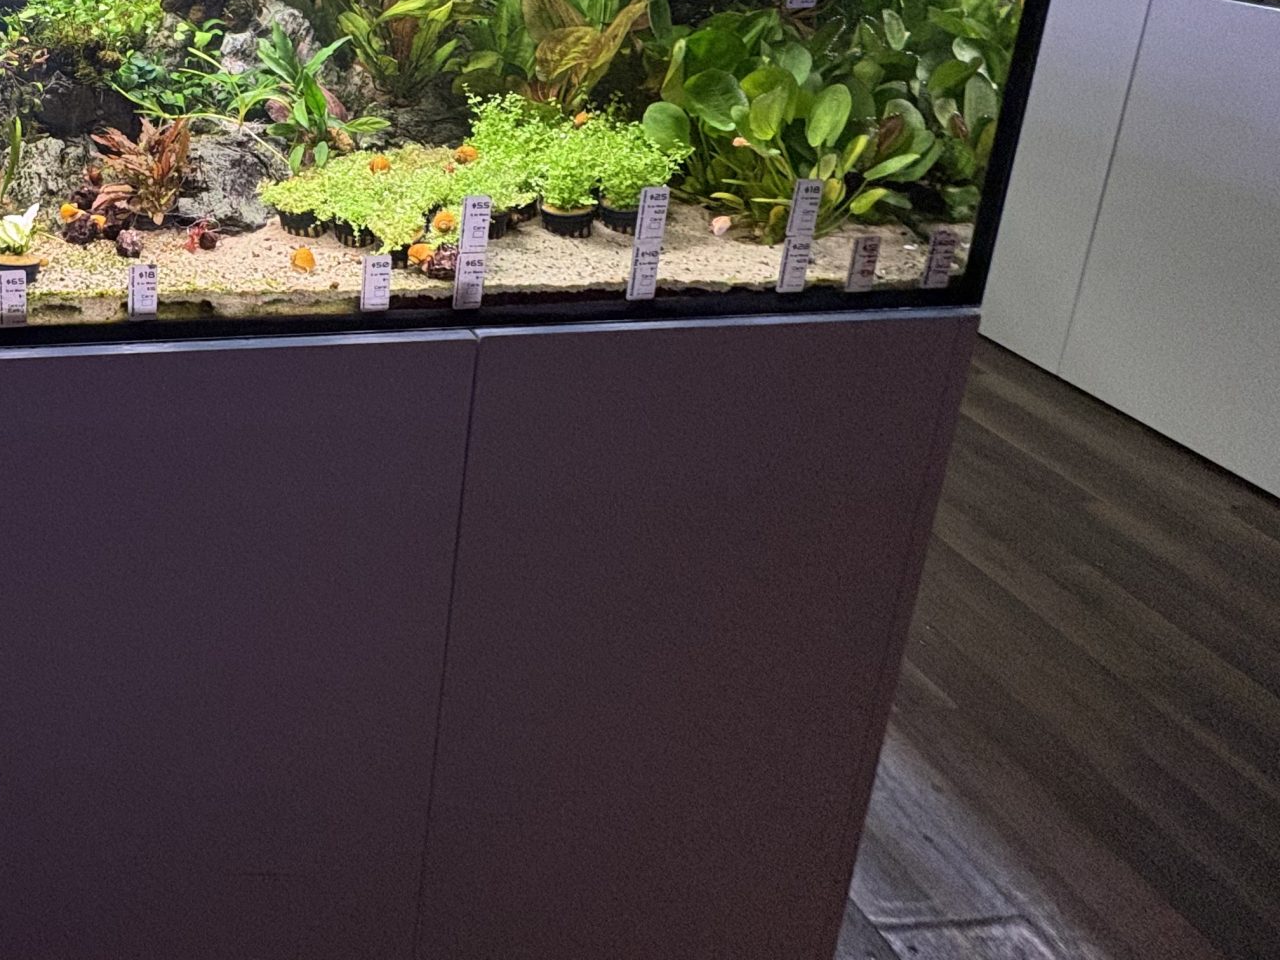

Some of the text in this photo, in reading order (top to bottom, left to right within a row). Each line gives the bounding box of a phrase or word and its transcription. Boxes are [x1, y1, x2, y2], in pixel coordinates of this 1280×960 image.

[472, 201, 490, 209] $55
[371, 261, 390, 269] $50
[465, 259, 484, 267] $65
[138, 271, 155, 279] $18
[6, 277, 24, 285] $65
